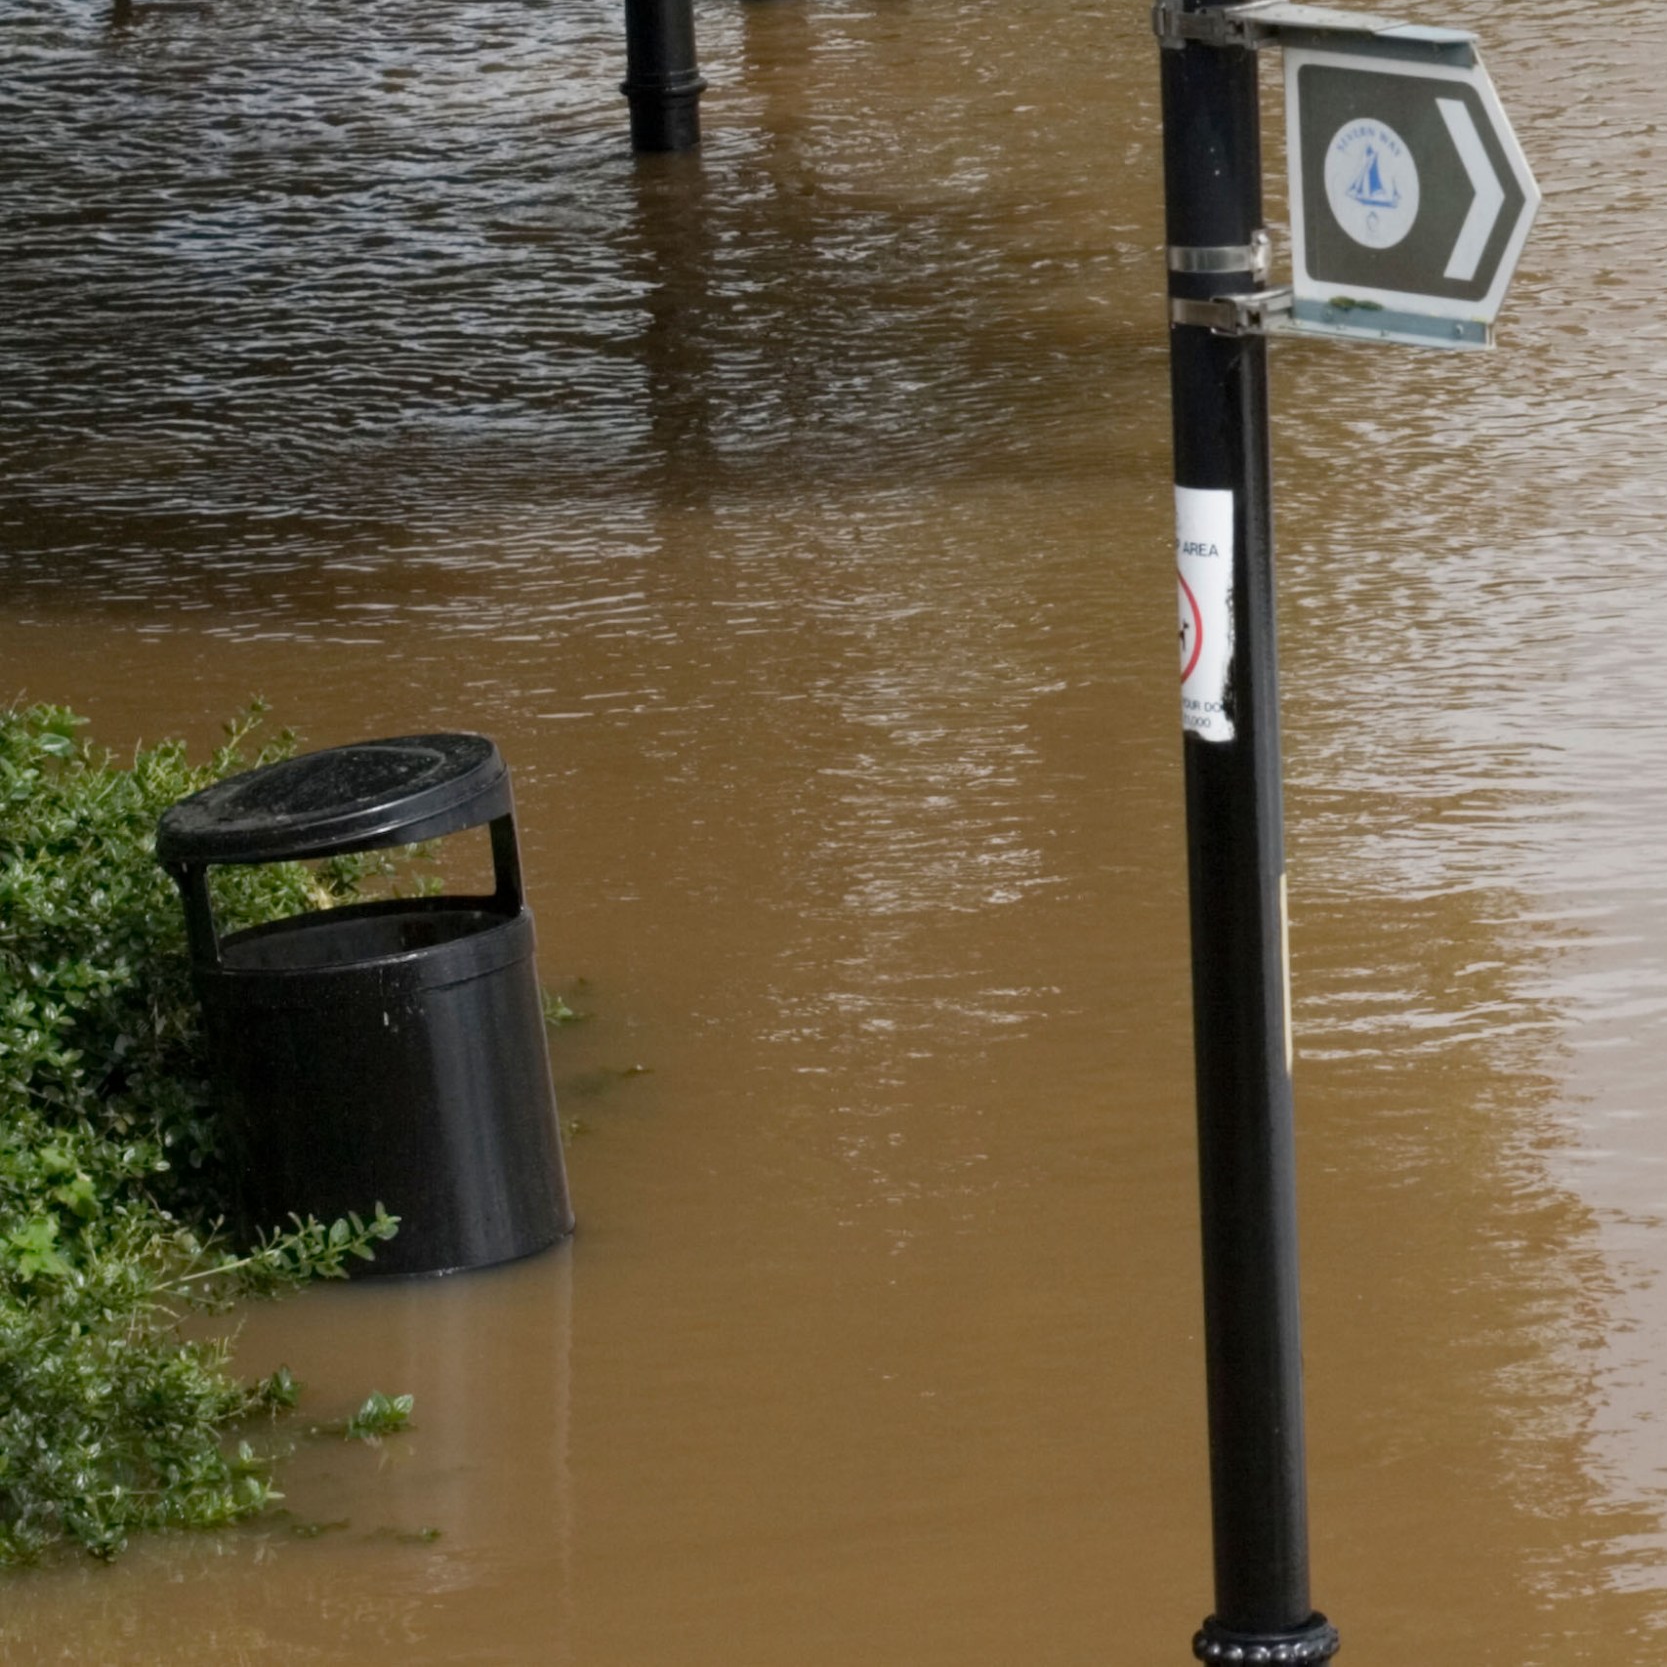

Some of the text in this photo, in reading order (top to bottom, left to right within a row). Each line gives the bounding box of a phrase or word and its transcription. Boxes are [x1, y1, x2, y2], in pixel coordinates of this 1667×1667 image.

[1336, 126, 1401, 157] SEVERN WAY
[1182, 541, 1219, 558] AREA
